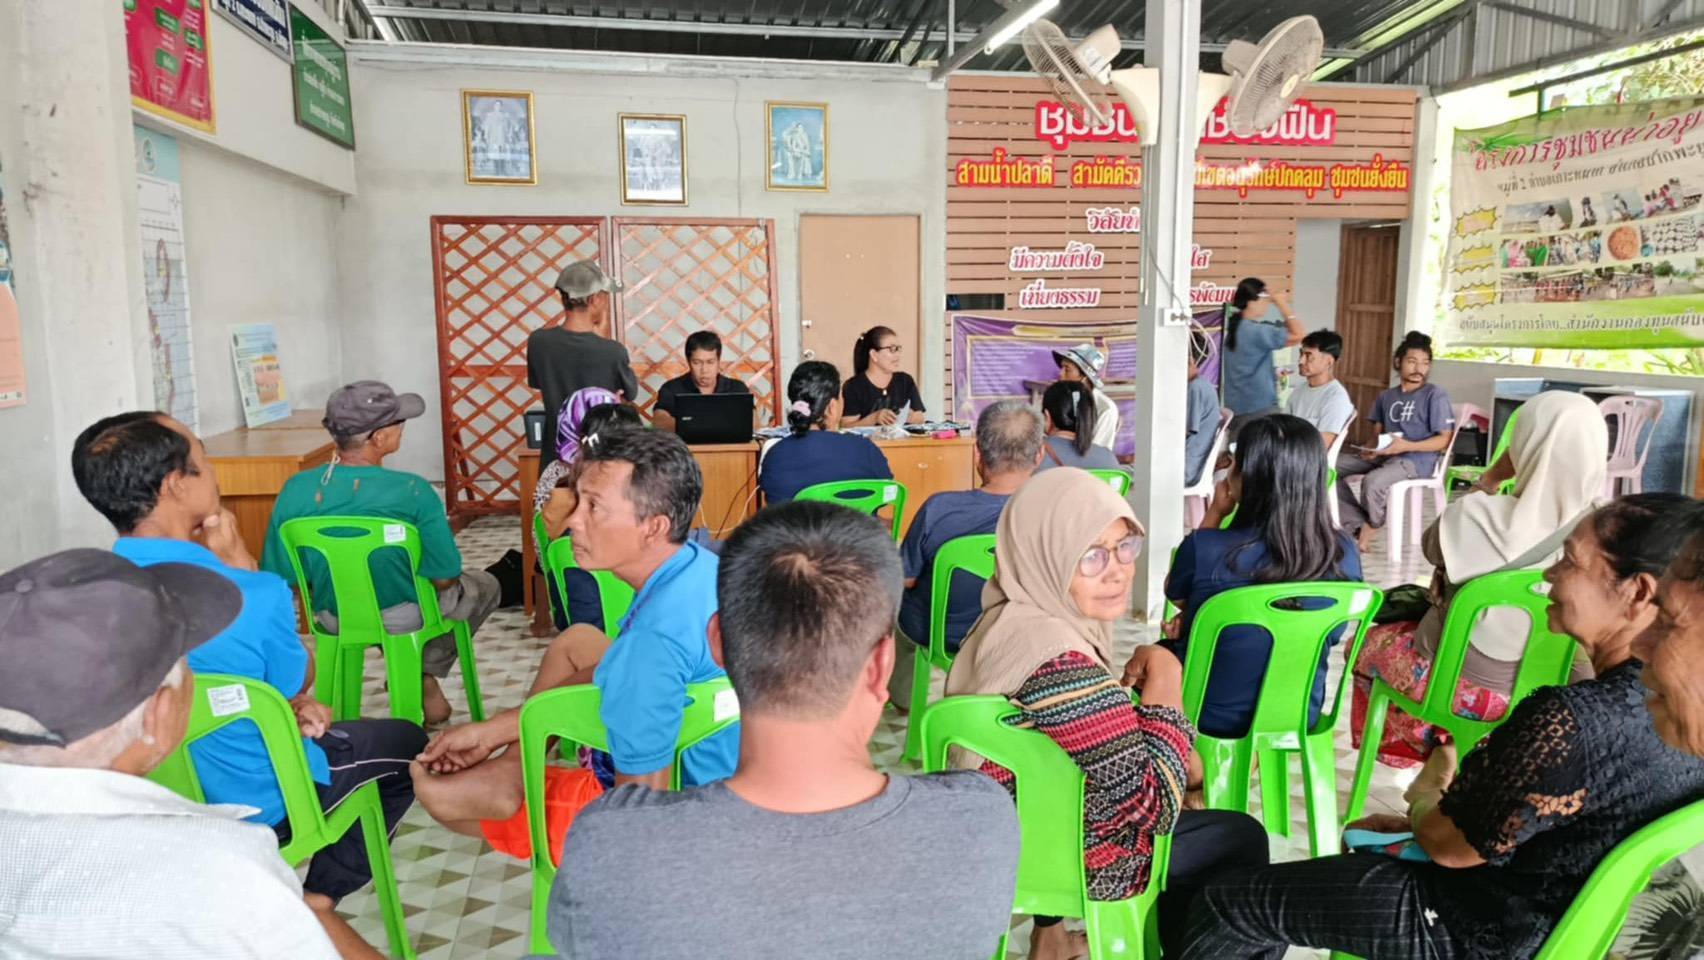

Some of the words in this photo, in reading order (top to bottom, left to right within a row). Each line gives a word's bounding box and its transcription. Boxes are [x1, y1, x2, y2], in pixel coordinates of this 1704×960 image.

[958, 150, 1053, 185] สามน้ำปลาดี
[1330, 154, 1407, 197] ชุมชนยั่งยืน
[1011, 244, 1102, 268] มีความตั้งใจ
[1020, 281, 1098, 306] เที่ยงธรรม
[1390, 401, 1415, 421] C#
